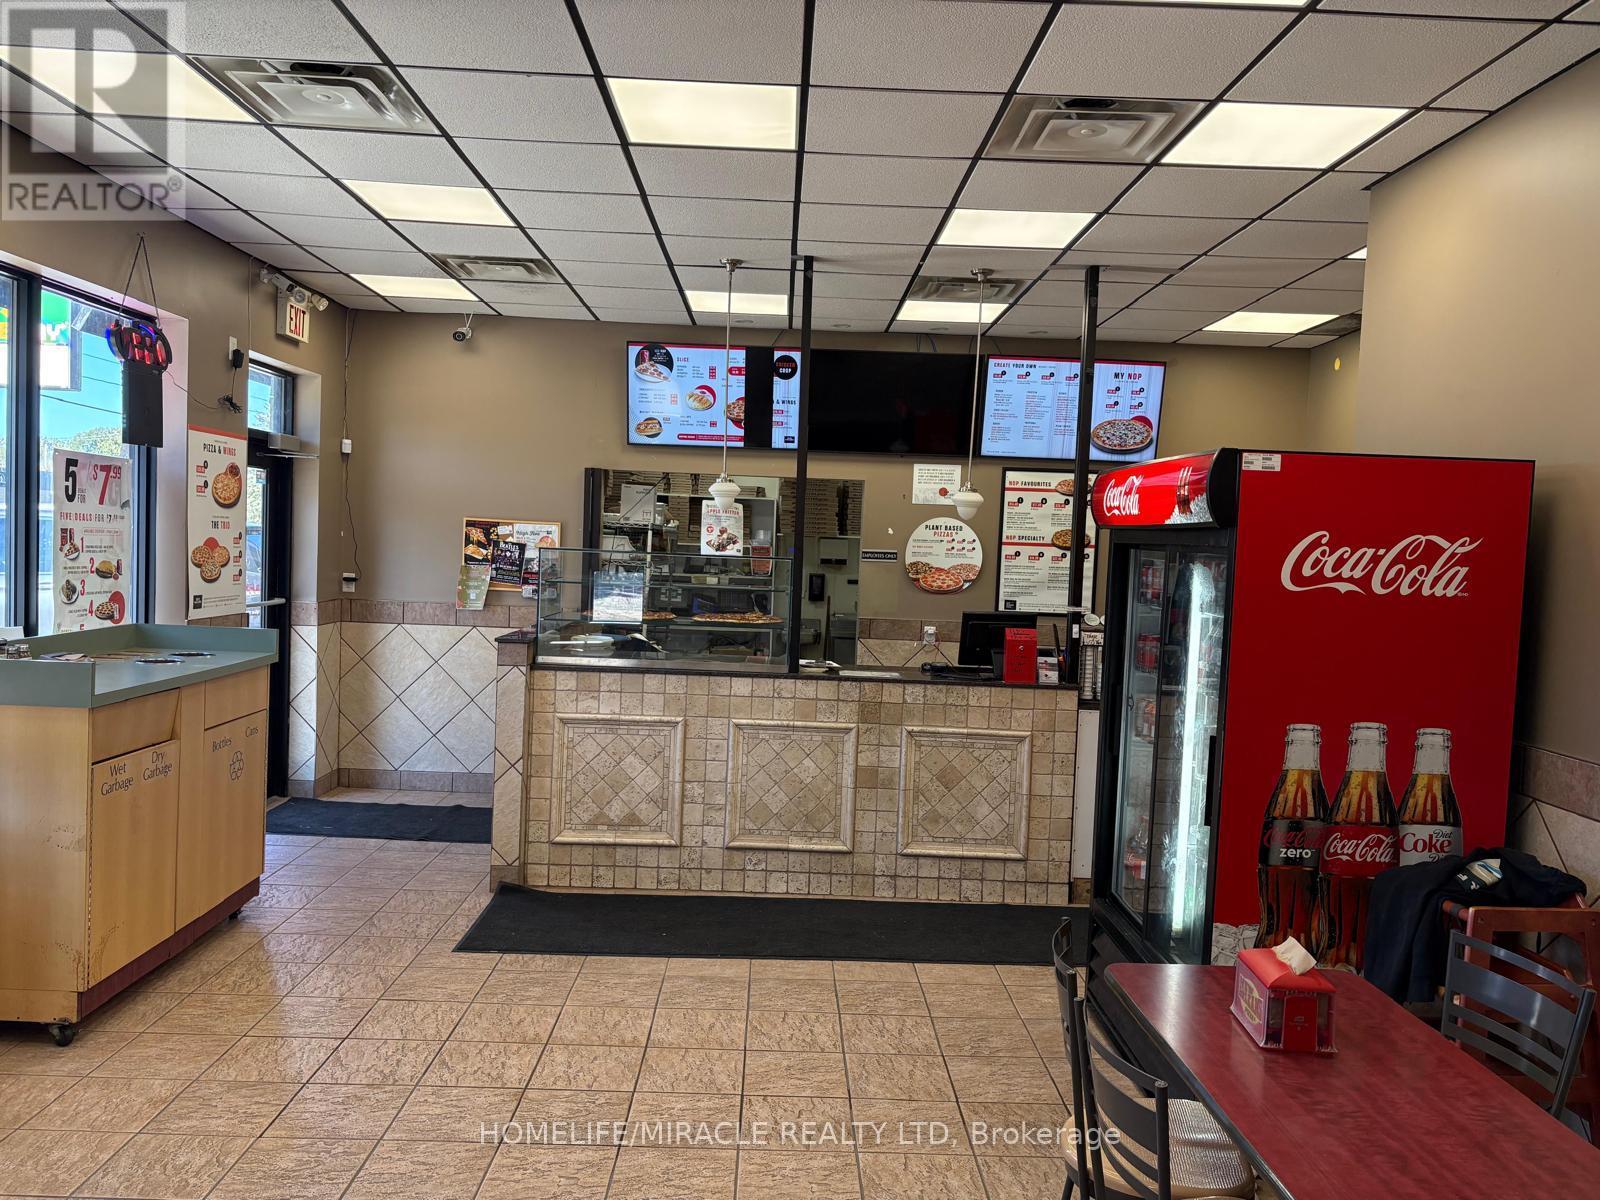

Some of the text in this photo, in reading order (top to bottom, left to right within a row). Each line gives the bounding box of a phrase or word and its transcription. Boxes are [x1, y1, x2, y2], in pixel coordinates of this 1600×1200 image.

[289, 304, 306, 339] EXIT
[1114, 372, 1142, 380] MY NOP
[203, 443, 217, 453] PIZZA
[223, 446, 237, 456] WINGS
[64, 457, 79, 503] 5
[1103, 474, 1145, 516] Coca-Cola
[60, 511, 72, 521] FIVE
[74, 512, 93, 522] DEALS
[94, 513, 105, 523] FOR
[211, 521, 220, 530] THE
[1280, 530, 1483, 597] Coca-Cola
[212, 736, 232, 753] Bottles
[151, 750, 166, 765] Dry
[109, 761, 127, 777] Wet
[143, 762, 173, 781] Garbage
[100, 776, 134, 796] Garbage
[1432, 828, 1453, 839] Diet
[1323, 832, 1397, 862] Coca-Cola
[1399, 832, 1452, 854] Coke
[1279, 847, 1312, 859] zero
